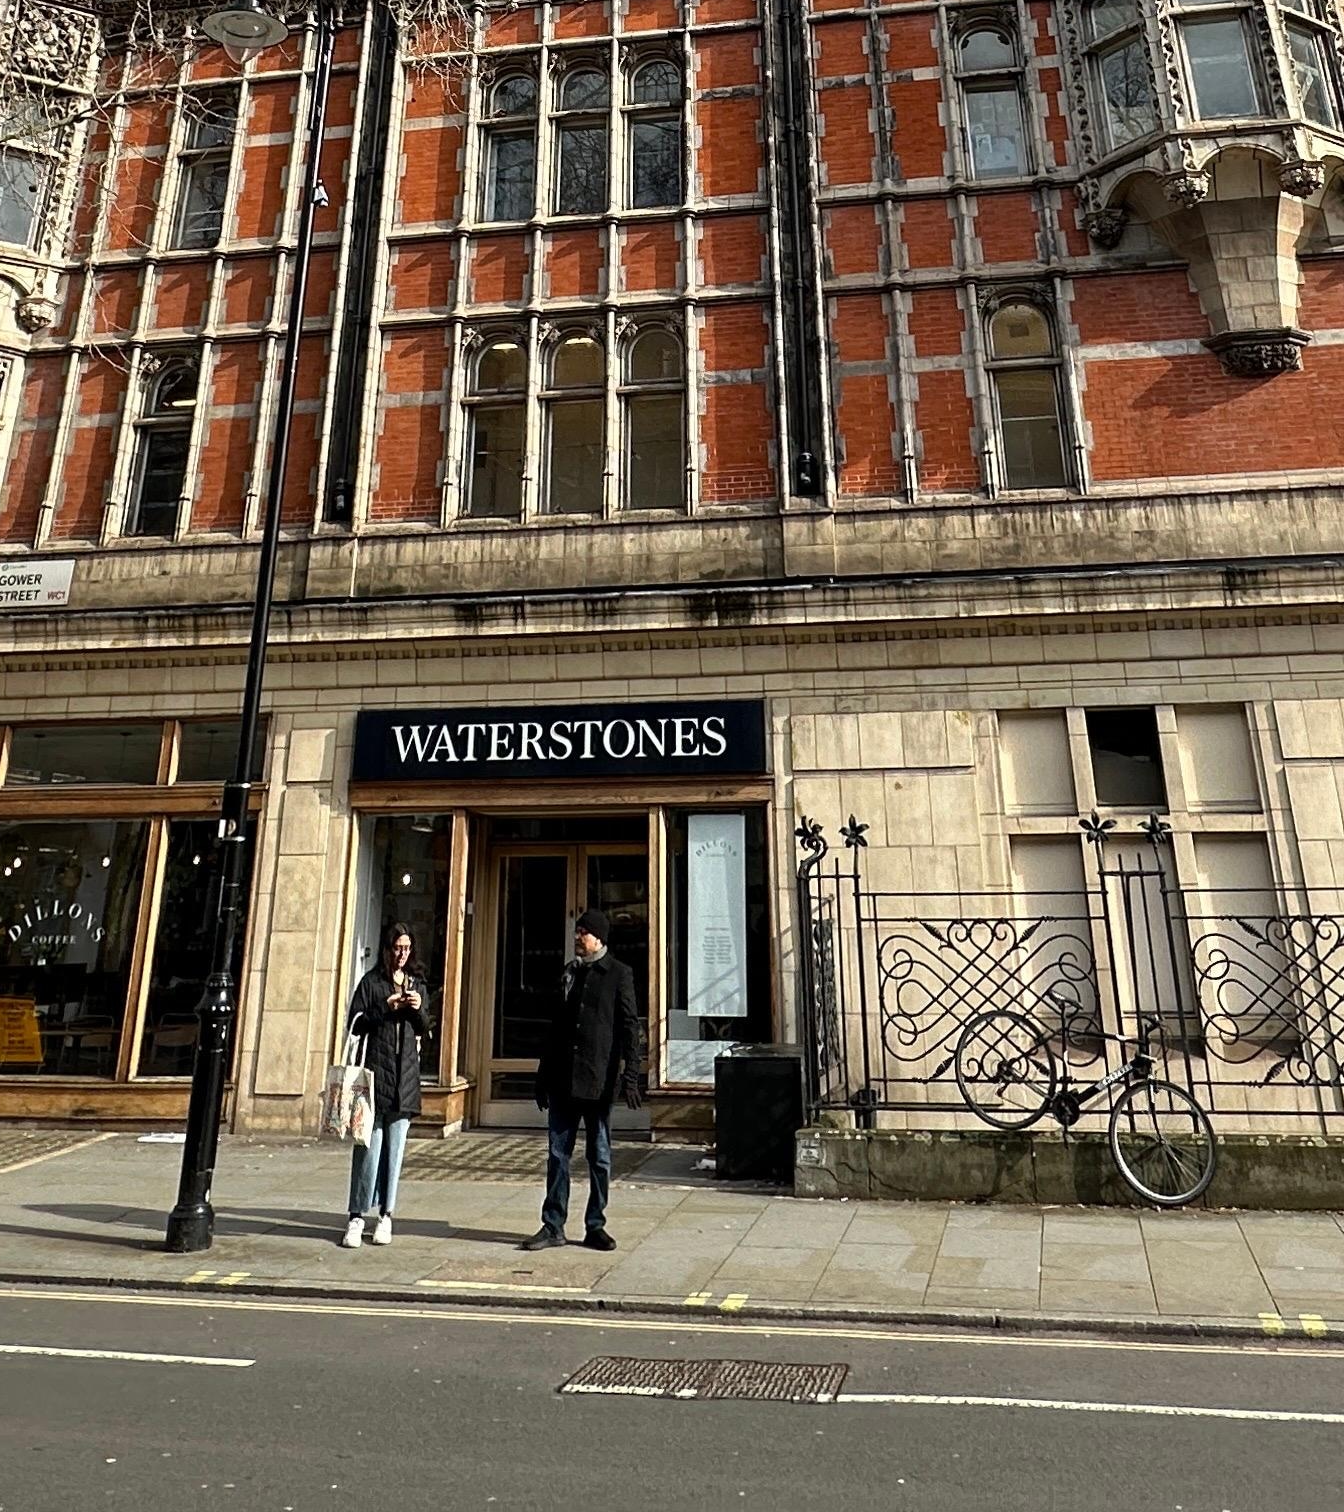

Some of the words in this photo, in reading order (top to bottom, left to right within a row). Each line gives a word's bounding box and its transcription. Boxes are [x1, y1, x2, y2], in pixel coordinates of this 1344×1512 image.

[391, 717, 727, 763] WATERSTONES
[8, 899, 105, 943] DILLONS
[31, 935, 76, 945] COFFEE
